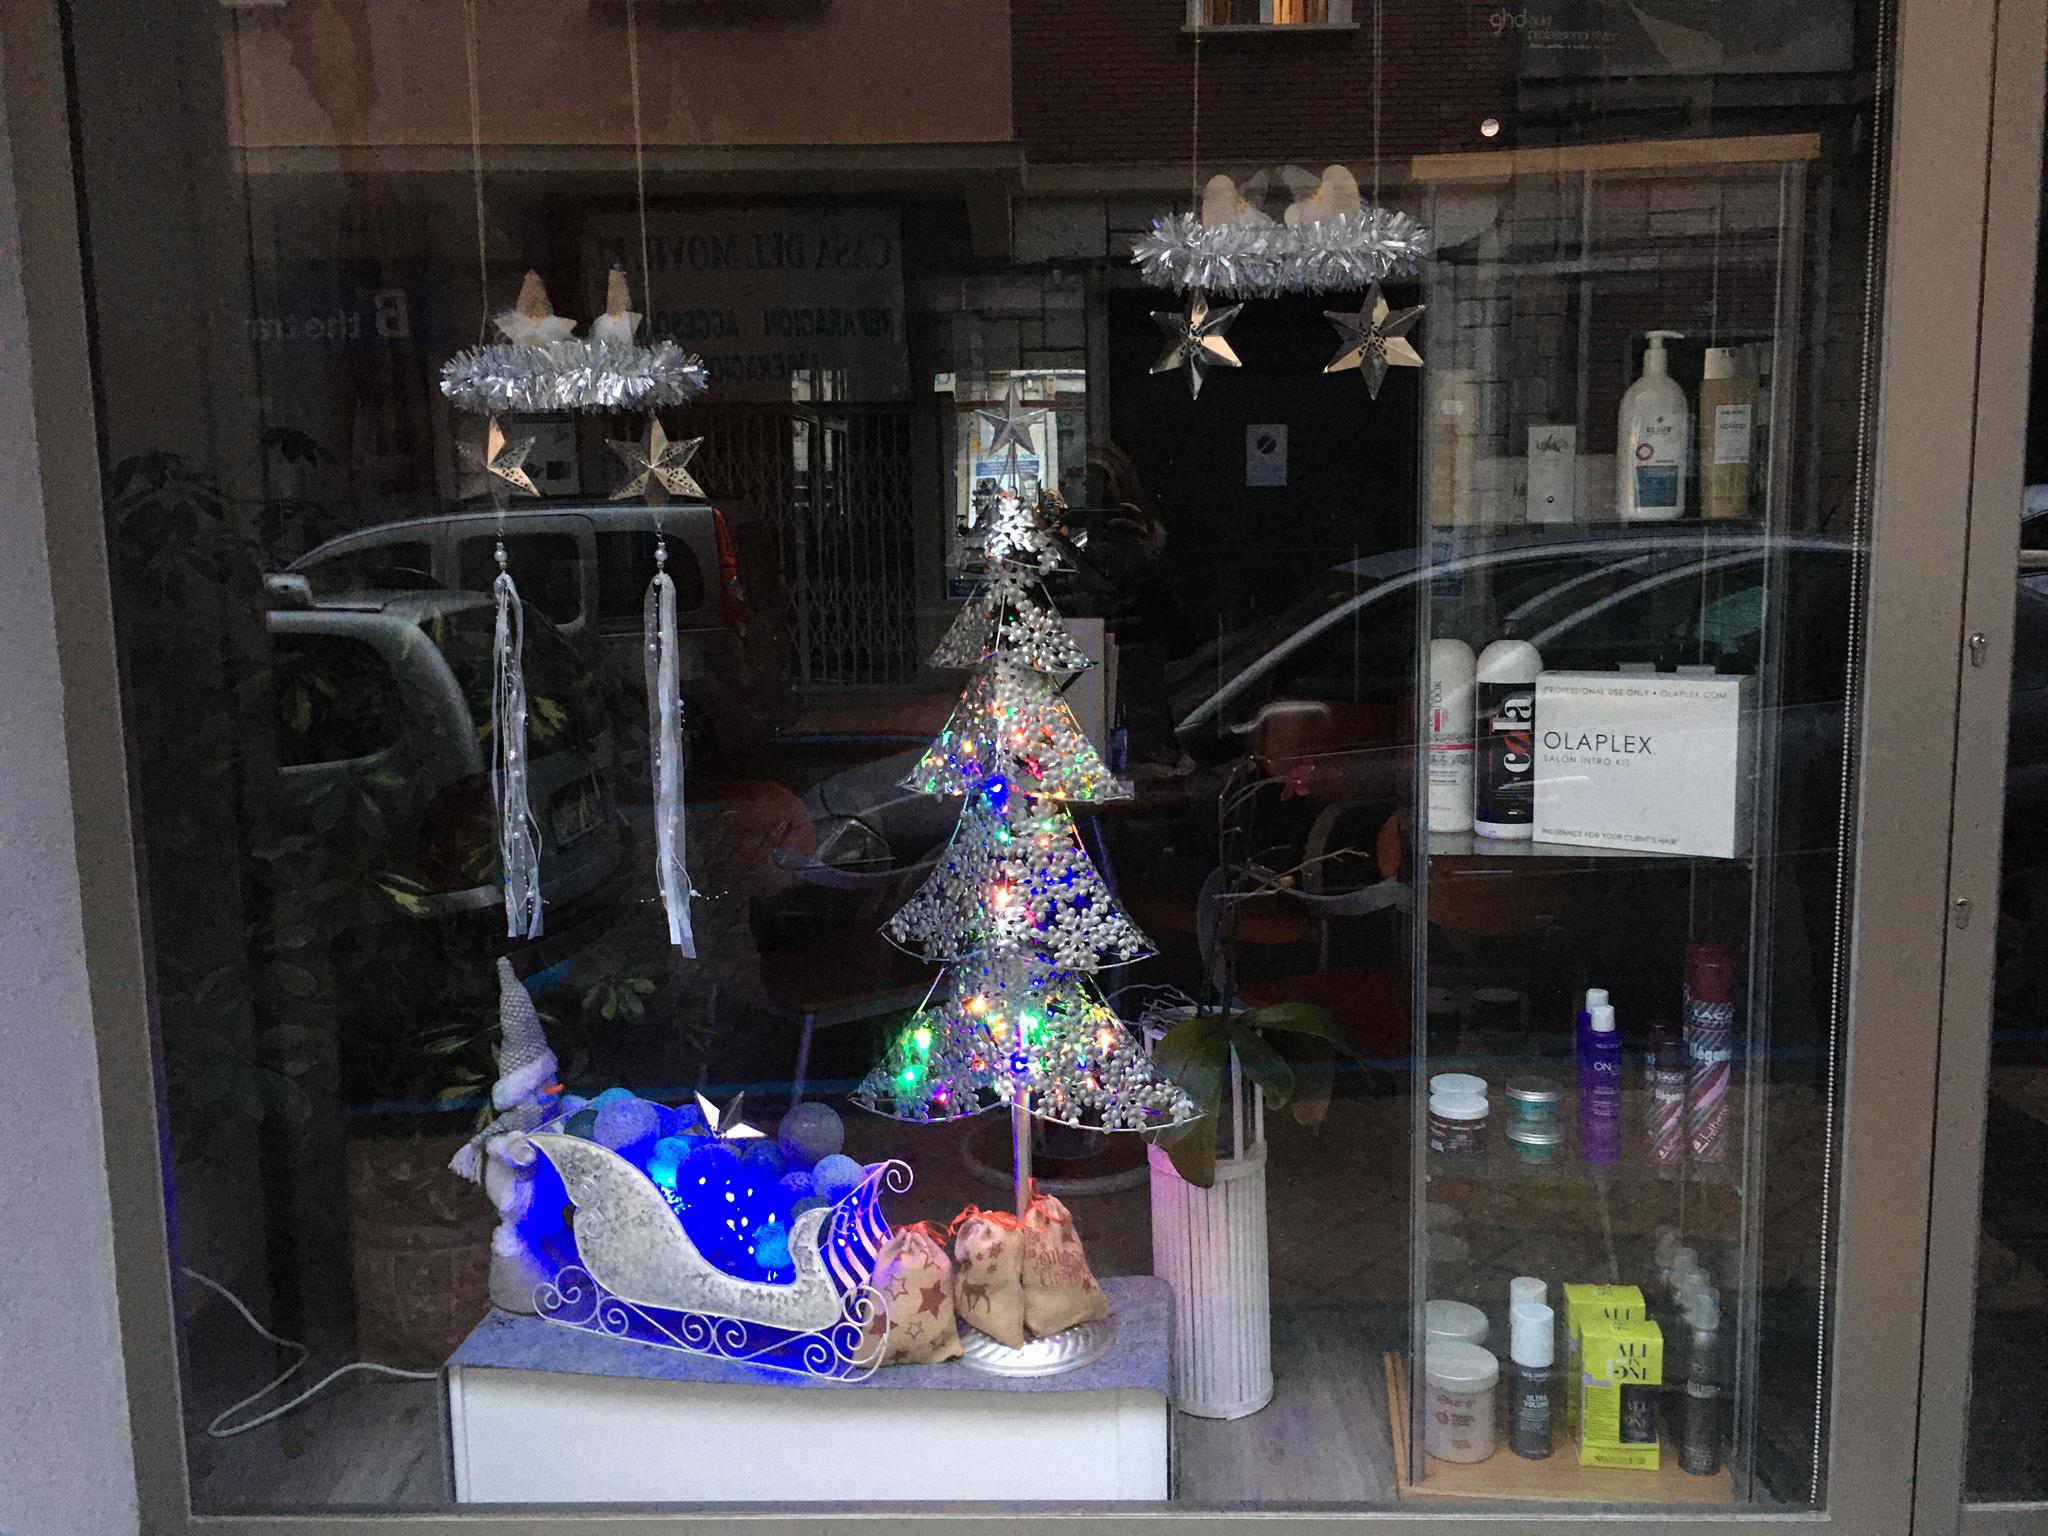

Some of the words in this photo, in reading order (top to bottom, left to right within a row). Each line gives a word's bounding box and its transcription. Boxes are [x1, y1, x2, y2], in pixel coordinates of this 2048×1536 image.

[1490, 8, 1527, 37] ghd
[1608, 688, 1624, 697] USE
[1626, 688, 1649, 697] ONLY
[1543, 731, 1652, 755] OLAPLEX
[1543, 754, 1577, 764] SALON
[1580, 756, 1612, 767] INTRO
[1618, 1343, 1647, 1358] ALL
